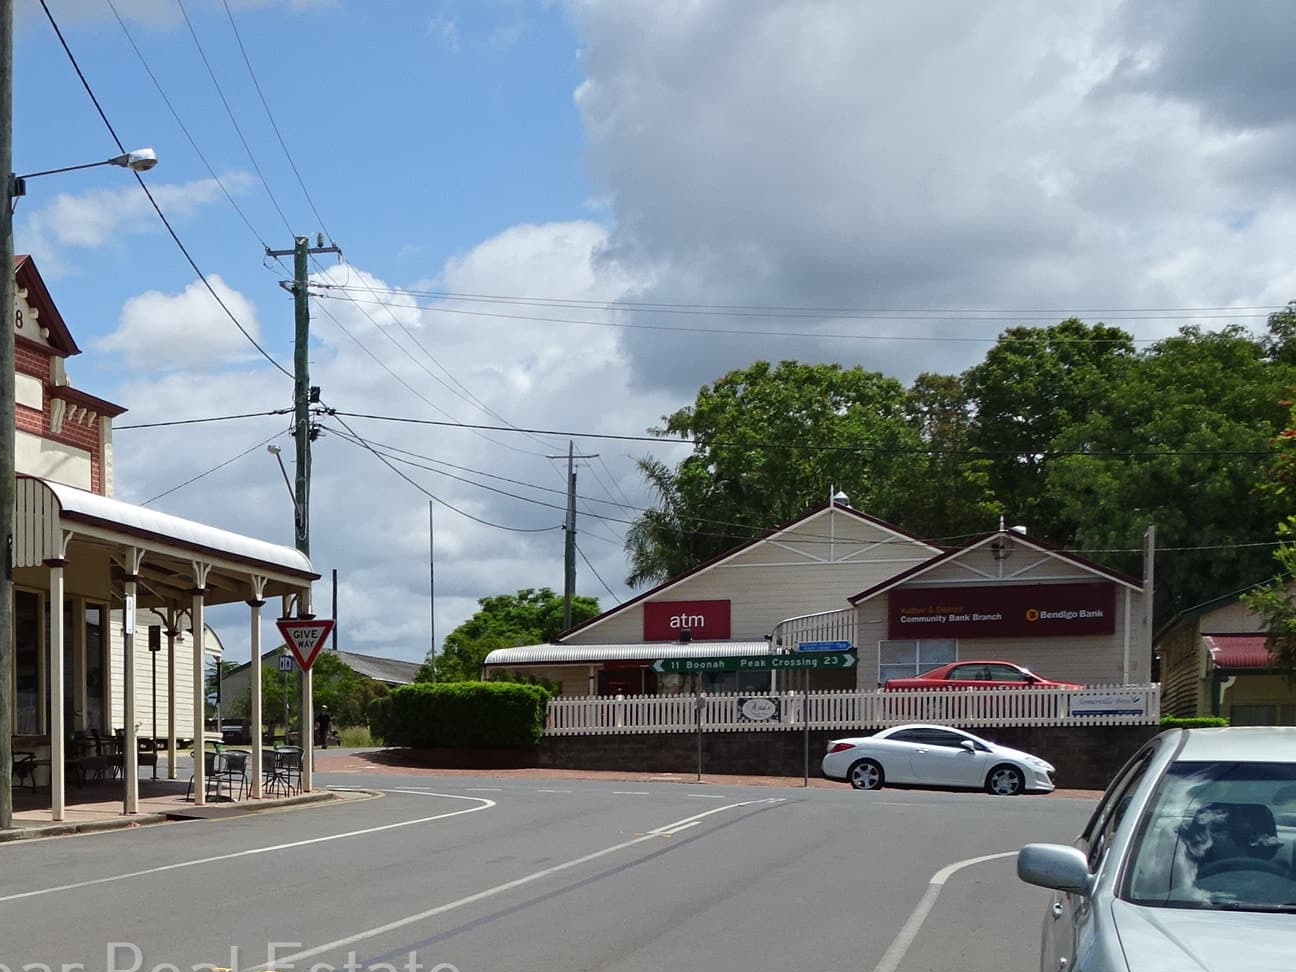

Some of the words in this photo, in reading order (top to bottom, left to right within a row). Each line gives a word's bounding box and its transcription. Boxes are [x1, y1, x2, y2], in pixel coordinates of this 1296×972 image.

[900, 614, 946, 624] Community
[948, 613, 970, 622] Bank
[972, 612, 1002, 621] Branch
[1040, 610, 1078, 620] Bendigo
[1079, 609, 1103, 618] Bank
[670, 613, 705, 628] atm
[293, 629, 318, 639] GIVE
[686, 660, 725, 669] Boonah
[740, 659, 766, 667] Peak
[772, 657, 818, 667] Crossing
[824, 656, 839, 665] 23
